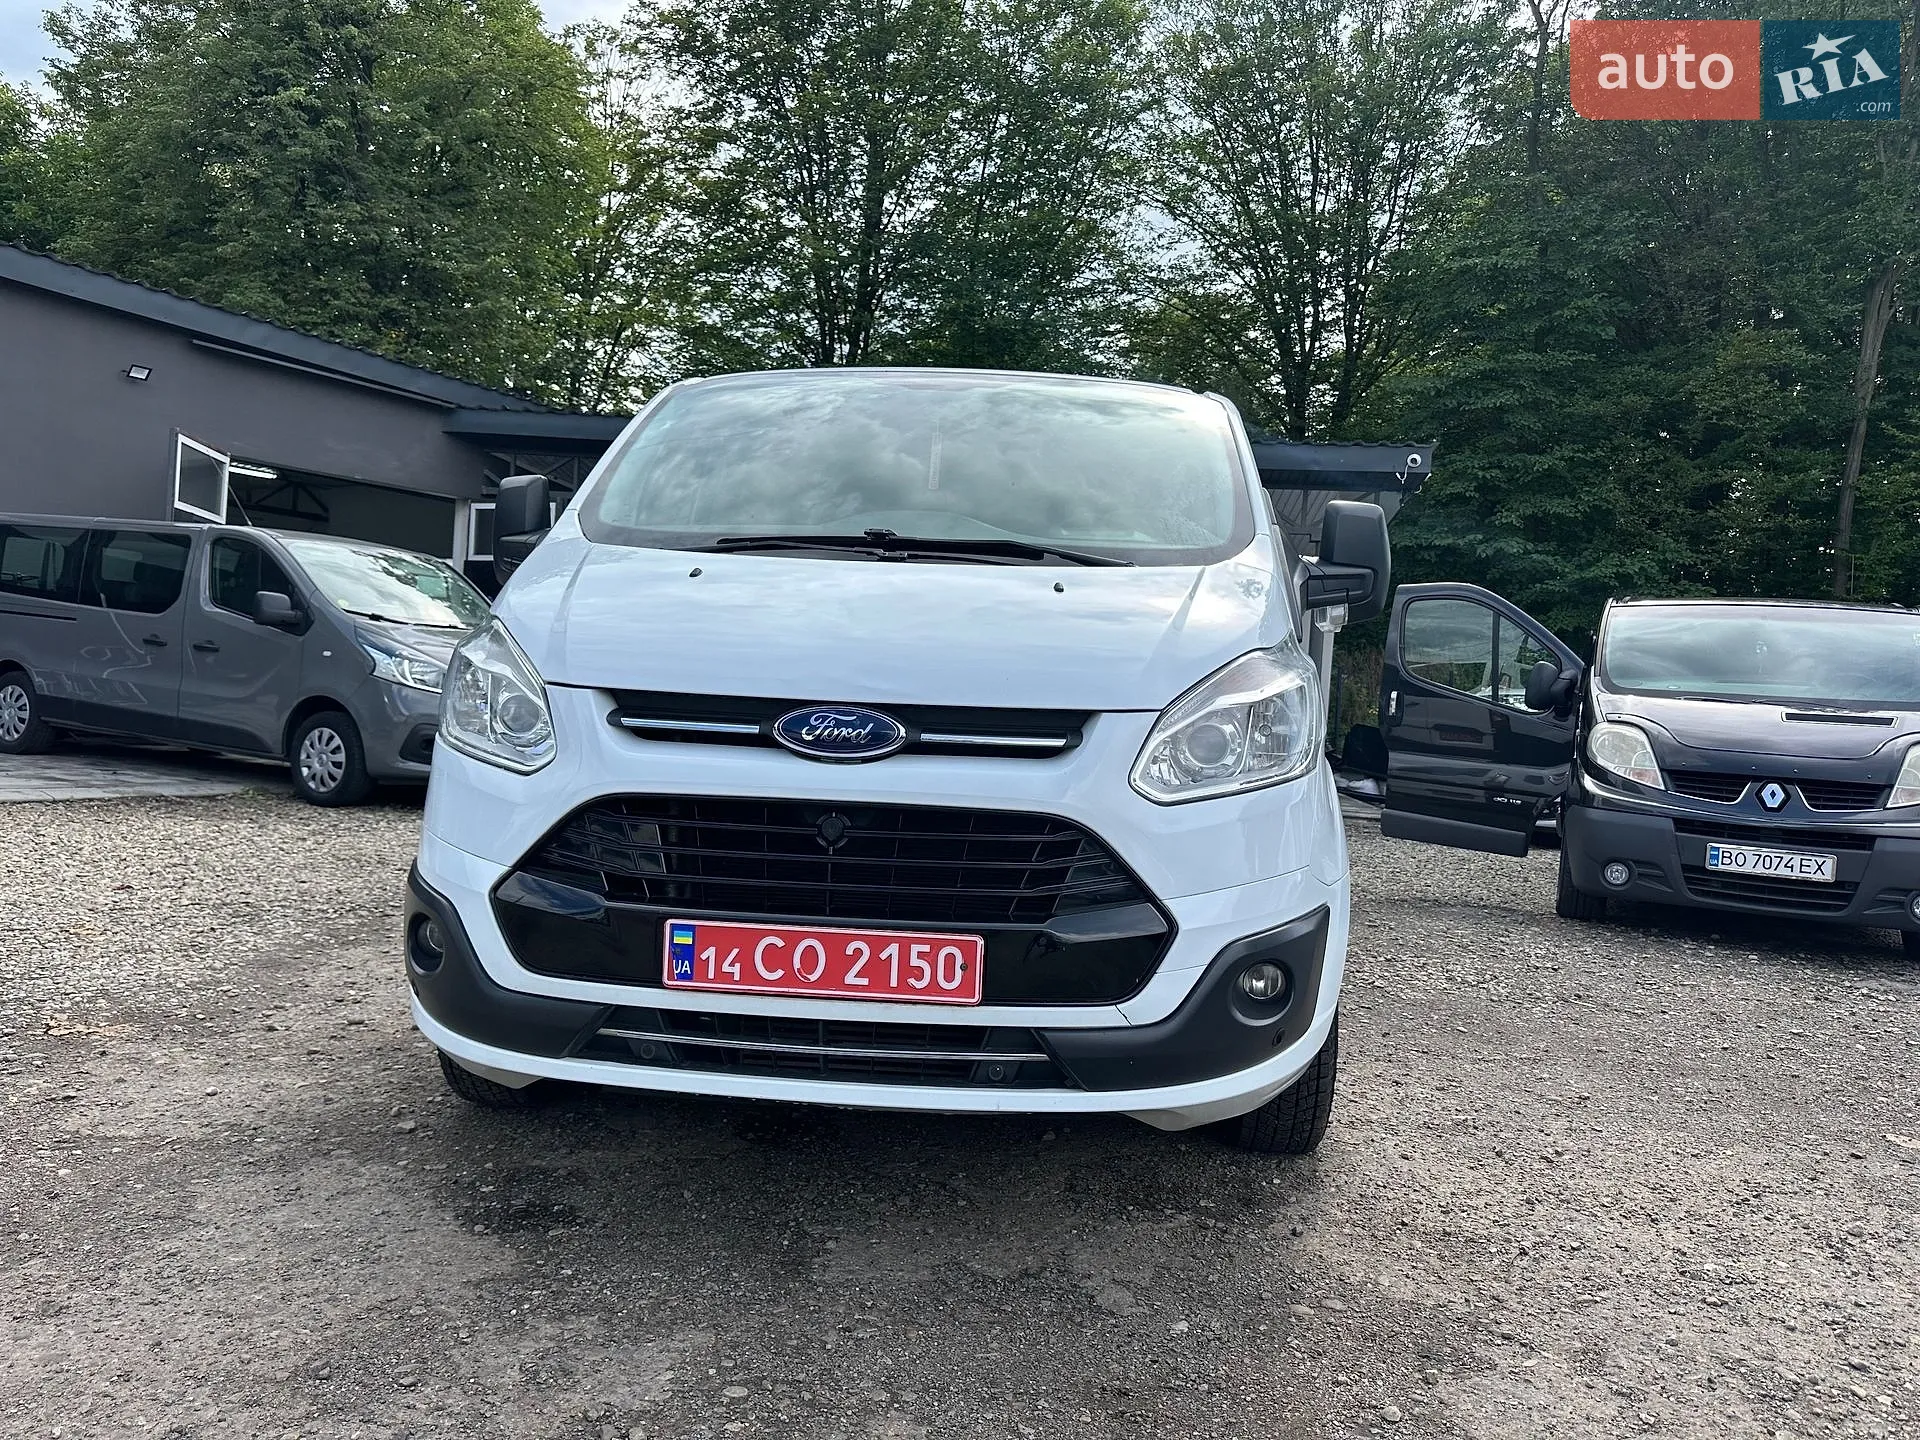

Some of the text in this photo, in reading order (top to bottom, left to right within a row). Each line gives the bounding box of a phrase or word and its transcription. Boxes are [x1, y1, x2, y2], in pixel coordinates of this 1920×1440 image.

[801, 712, 874, 743] Ford
[1720, 850, 1826, 876] BO 7074 EX
[672, 960, 691, 975] UA
[700, 936, 963, 990] 14 CO 2150
